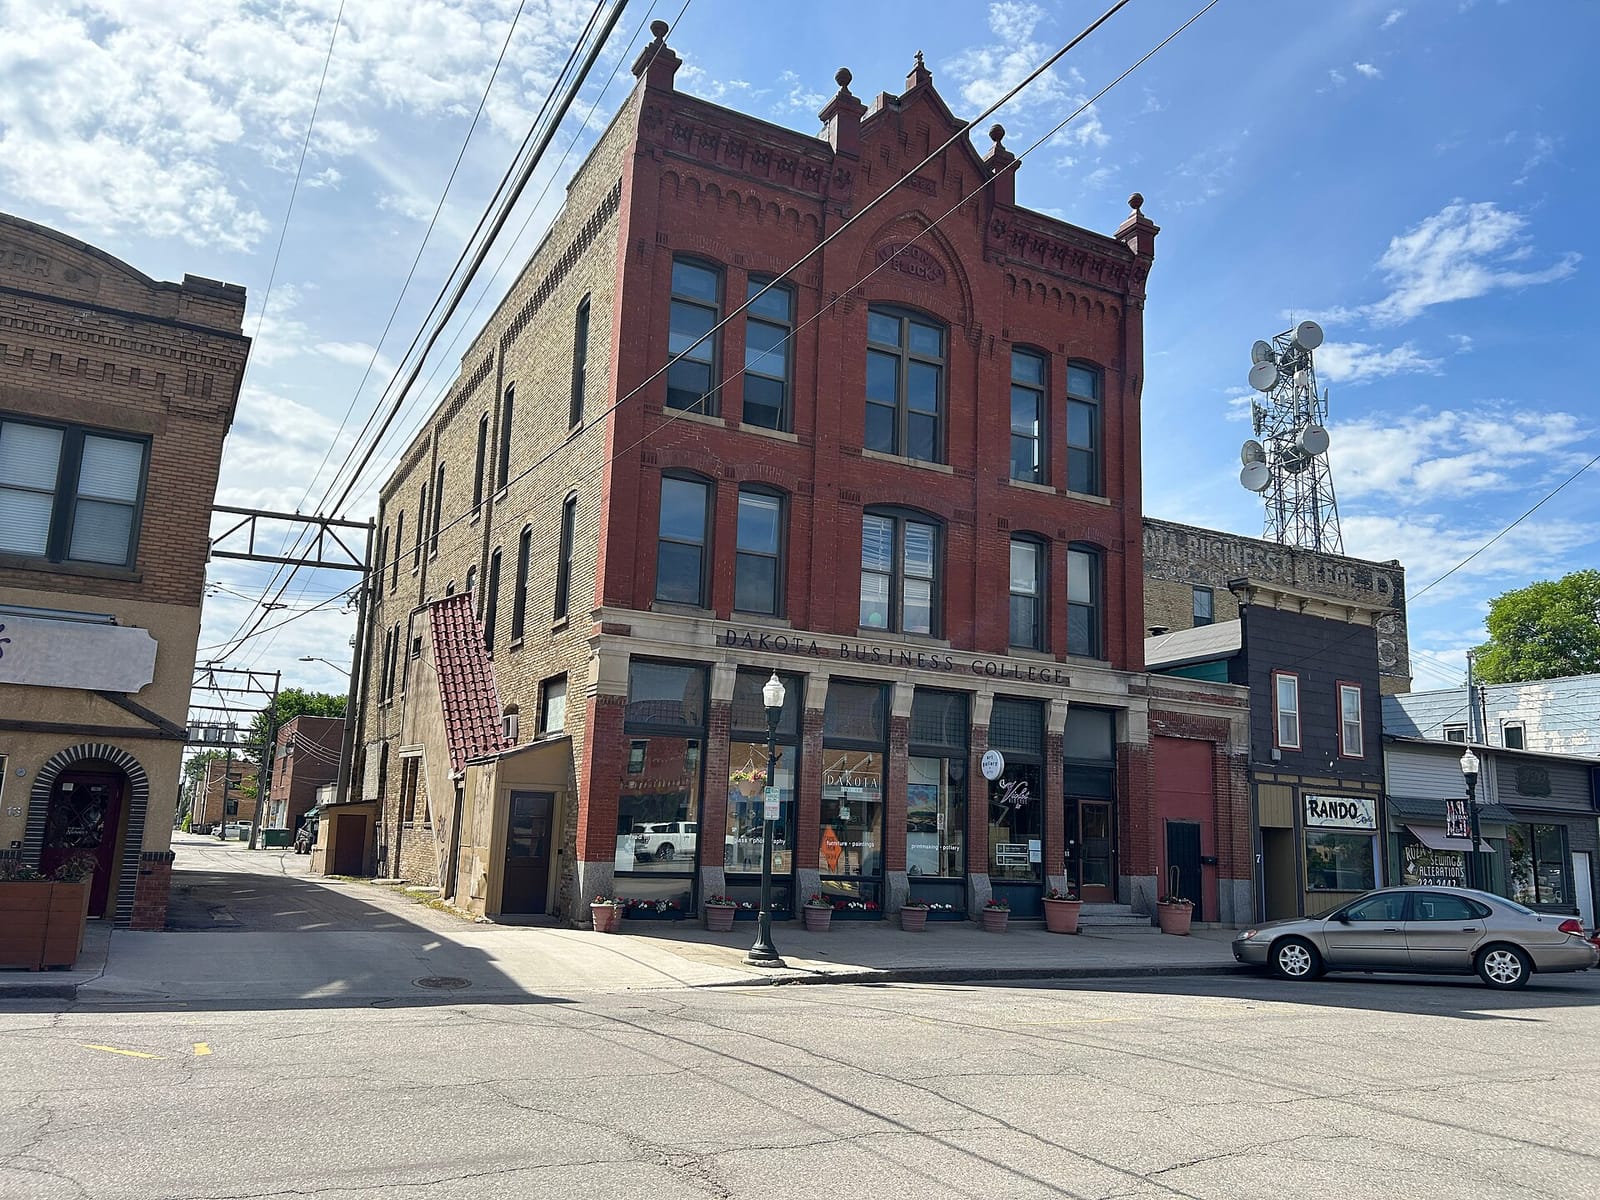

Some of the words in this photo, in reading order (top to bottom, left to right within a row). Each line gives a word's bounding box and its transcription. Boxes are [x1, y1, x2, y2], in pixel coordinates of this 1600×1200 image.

[725, 629, 820, 655] DAKOTA
[839, 643, 953, 671] BUSINESS
[971, 660, 1063, 684] COLLEGE
[1308, 800, 1358, 820] RANDO
[1256, 854, 1261, 863] 7
[1419, 866, 1465, 878] ALTERATIONS
